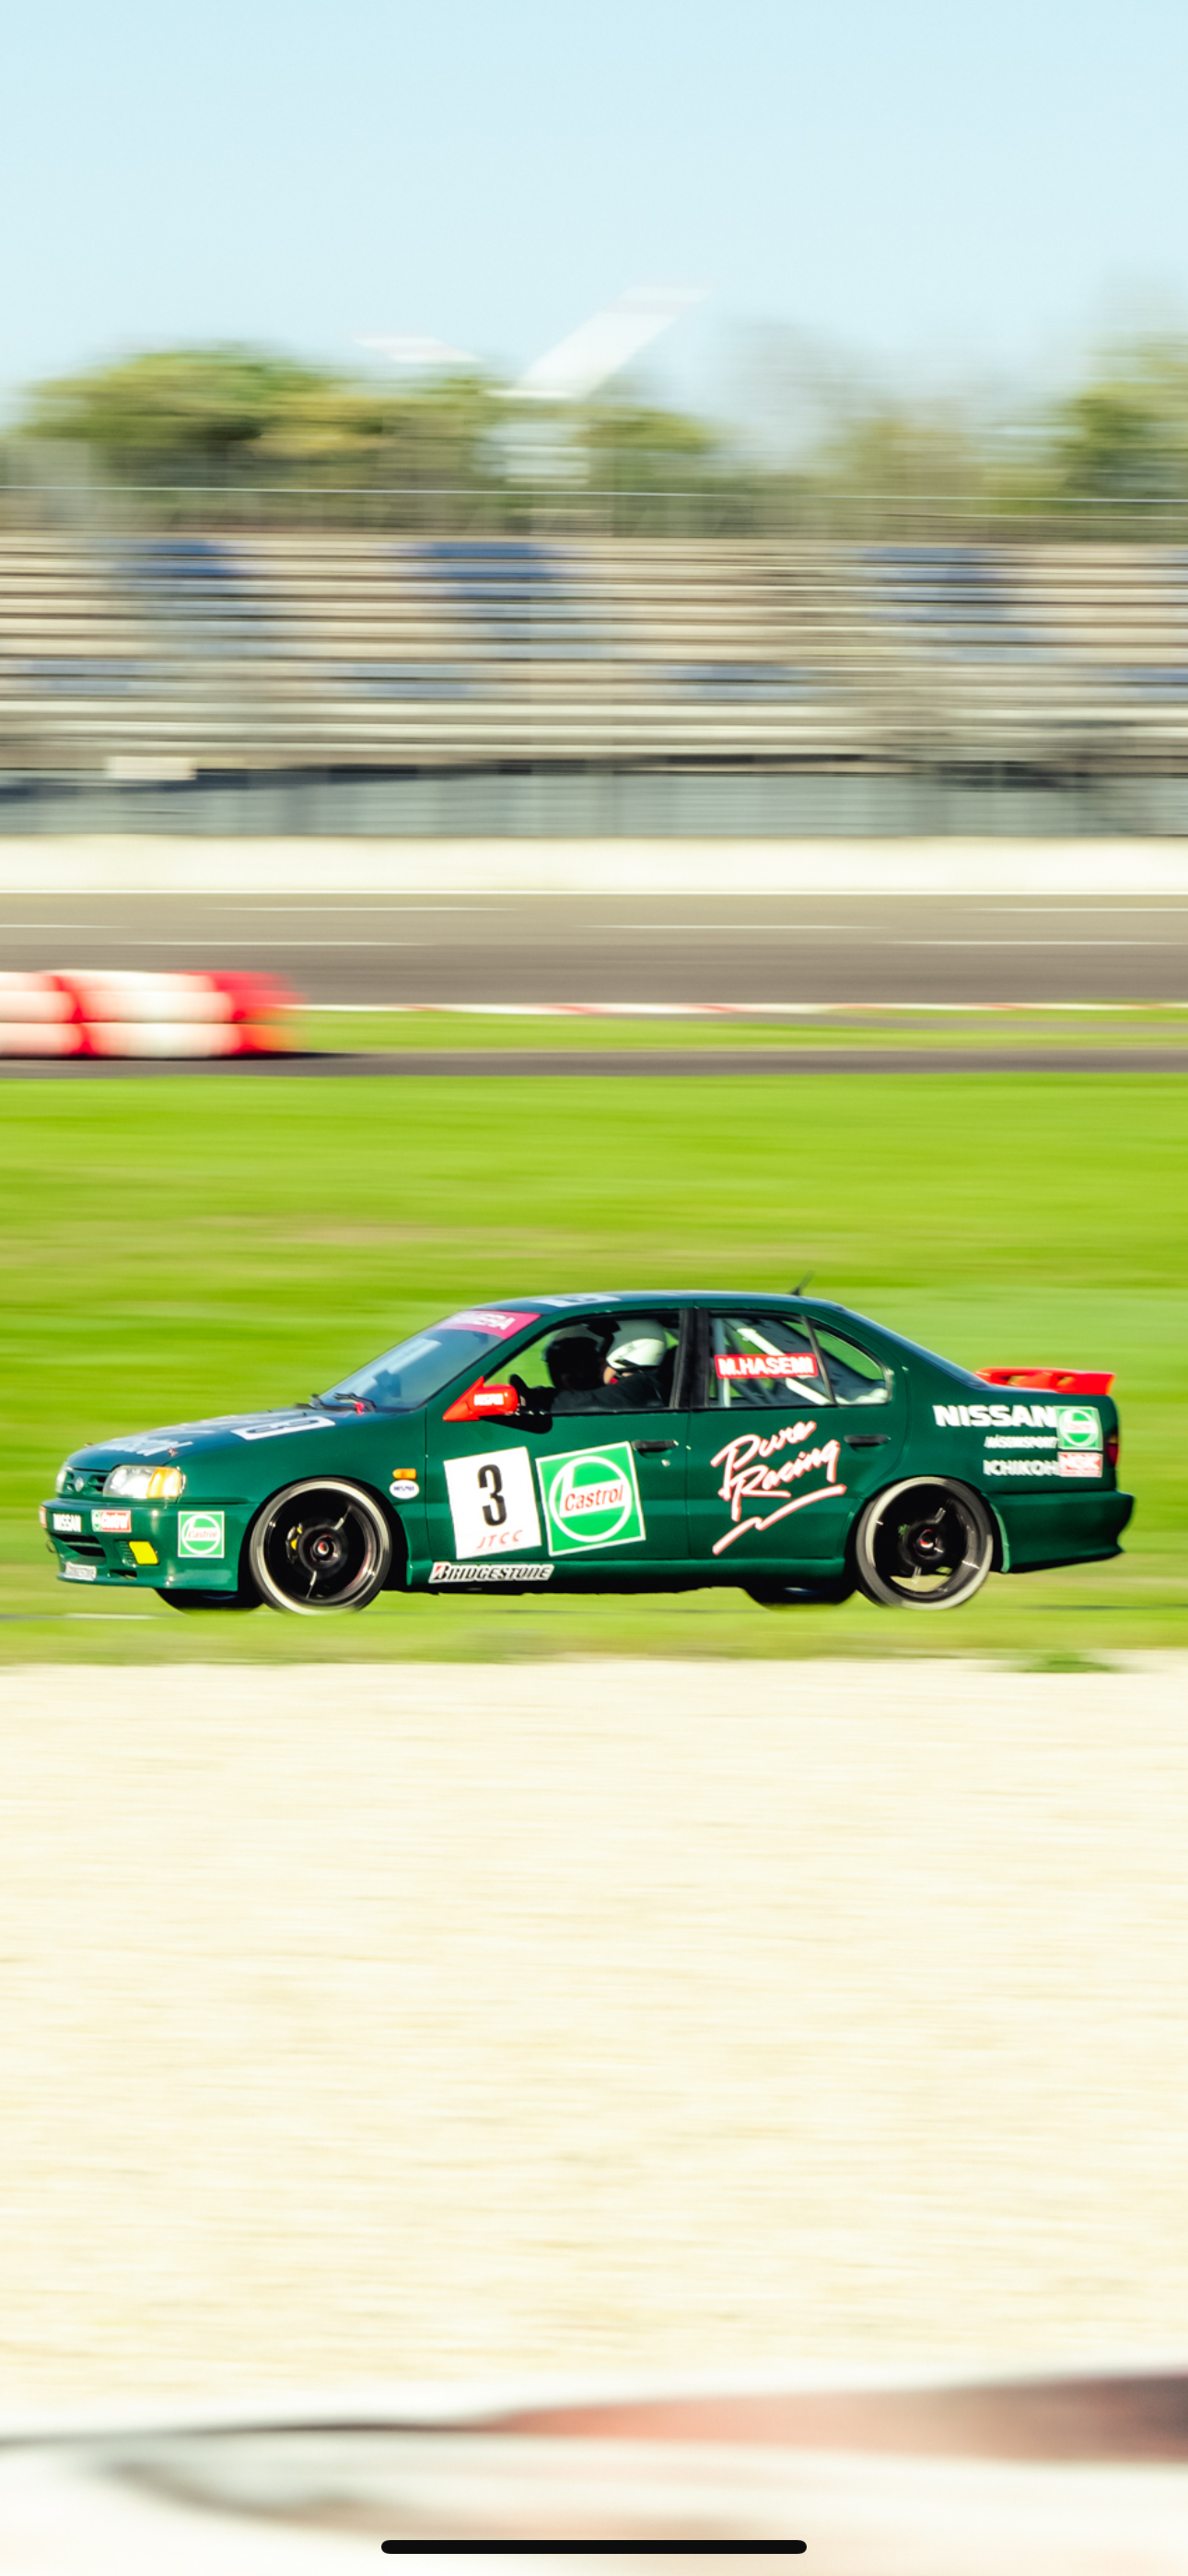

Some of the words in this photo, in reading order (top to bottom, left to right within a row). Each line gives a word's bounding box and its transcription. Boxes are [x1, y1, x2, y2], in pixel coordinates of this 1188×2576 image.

[717, 1356, 814, 1376] M.HASEMI
[932, 1405, 1058, 1428] NISSAN
[709, 1420, 818, 1502] Pure
[983, 1459, 1059, 1477] ICHIKOH
[728, 1438, 841, 1523] Racing
[477, 1463, 507, 1528] 3
[564, 1483, 624, 1513] Castrol
[52, 1513, 82, 1533] NISSAN
[187, 1529, 218, 1539] Castrol
[476, 1529, 523, 1550] JTCC
[433, 1563, 553, 1582] BRIDGESTONE
